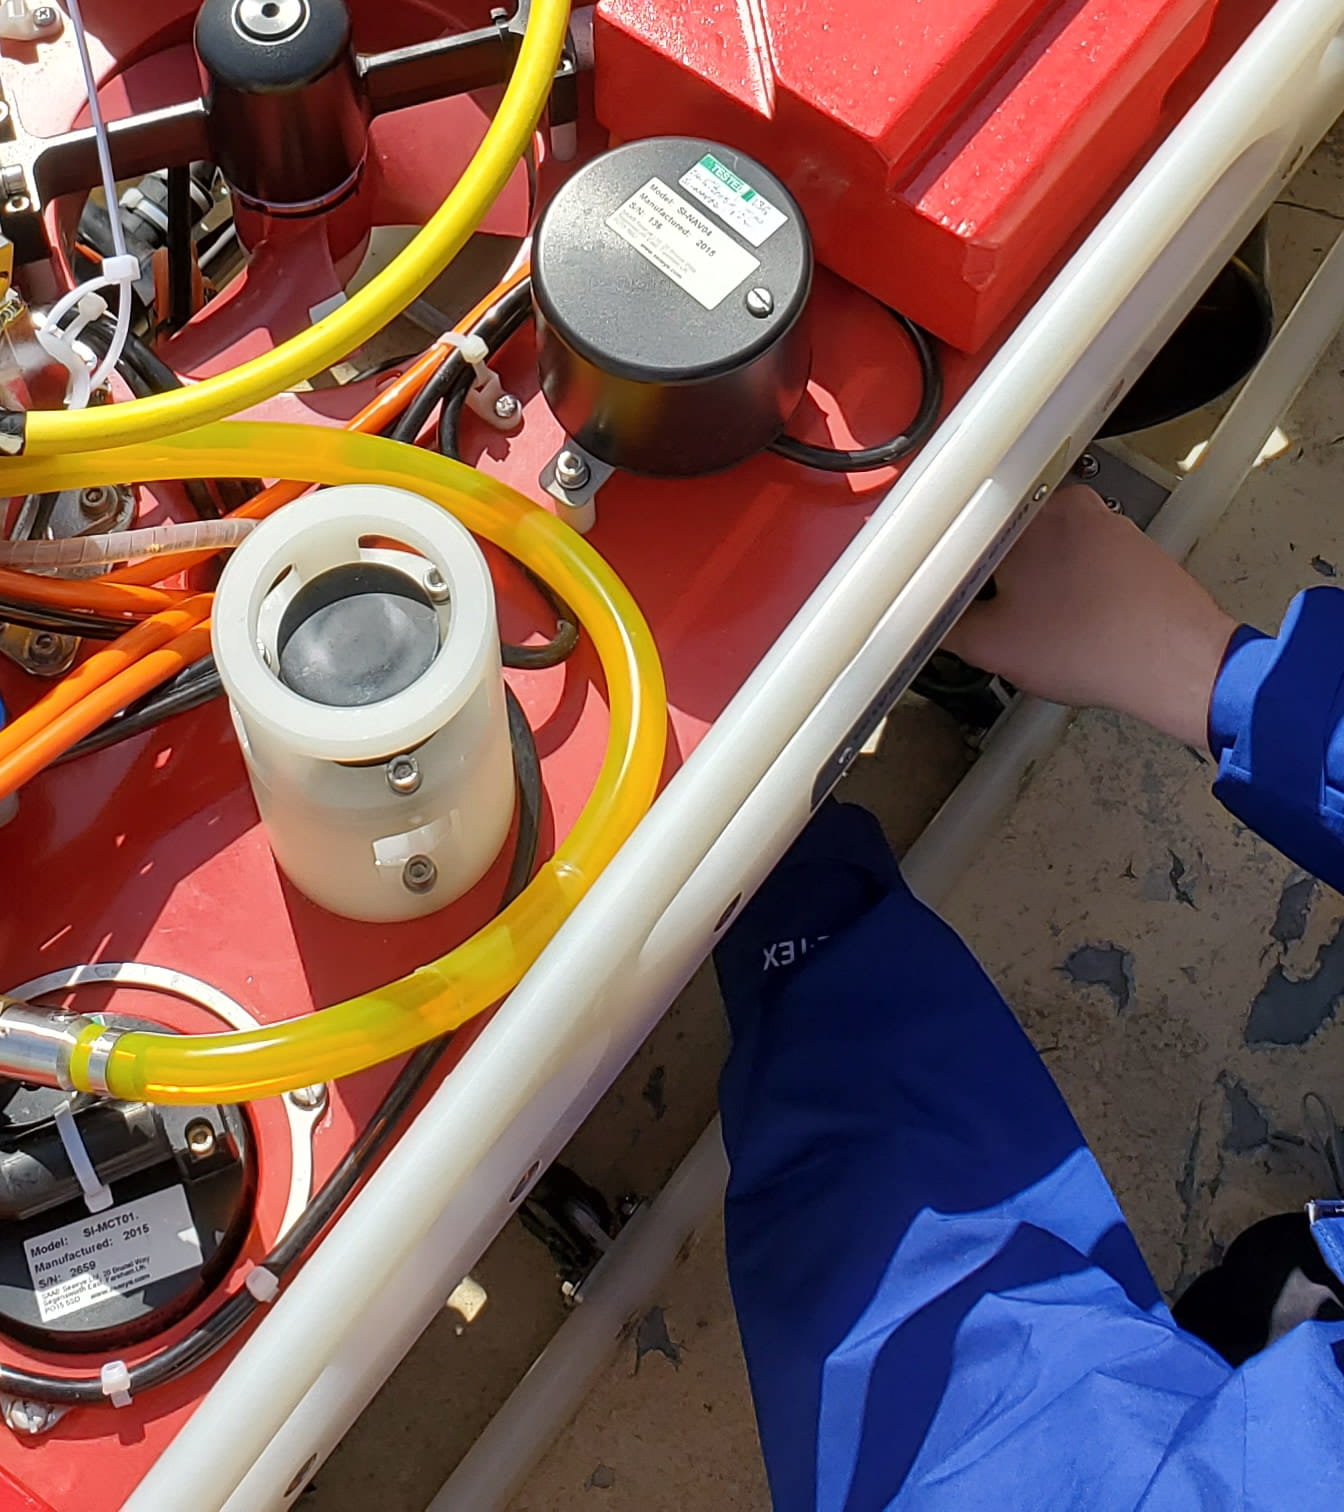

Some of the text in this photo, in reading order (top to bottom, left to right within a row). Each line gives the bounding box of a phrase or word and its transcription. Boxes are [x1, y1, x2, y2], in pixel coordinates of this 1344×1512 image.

[649, 183, 674, 205] Model:
[638, 192, 691, 237] Manufactured:
[696, 239, 715, 257] 2015
[30, 1237, 69, 1257] Model:
[34, 1223, 150, 1273] Manufactured: 2015
[38, 1260, 97, 1289] S/N: 2659
